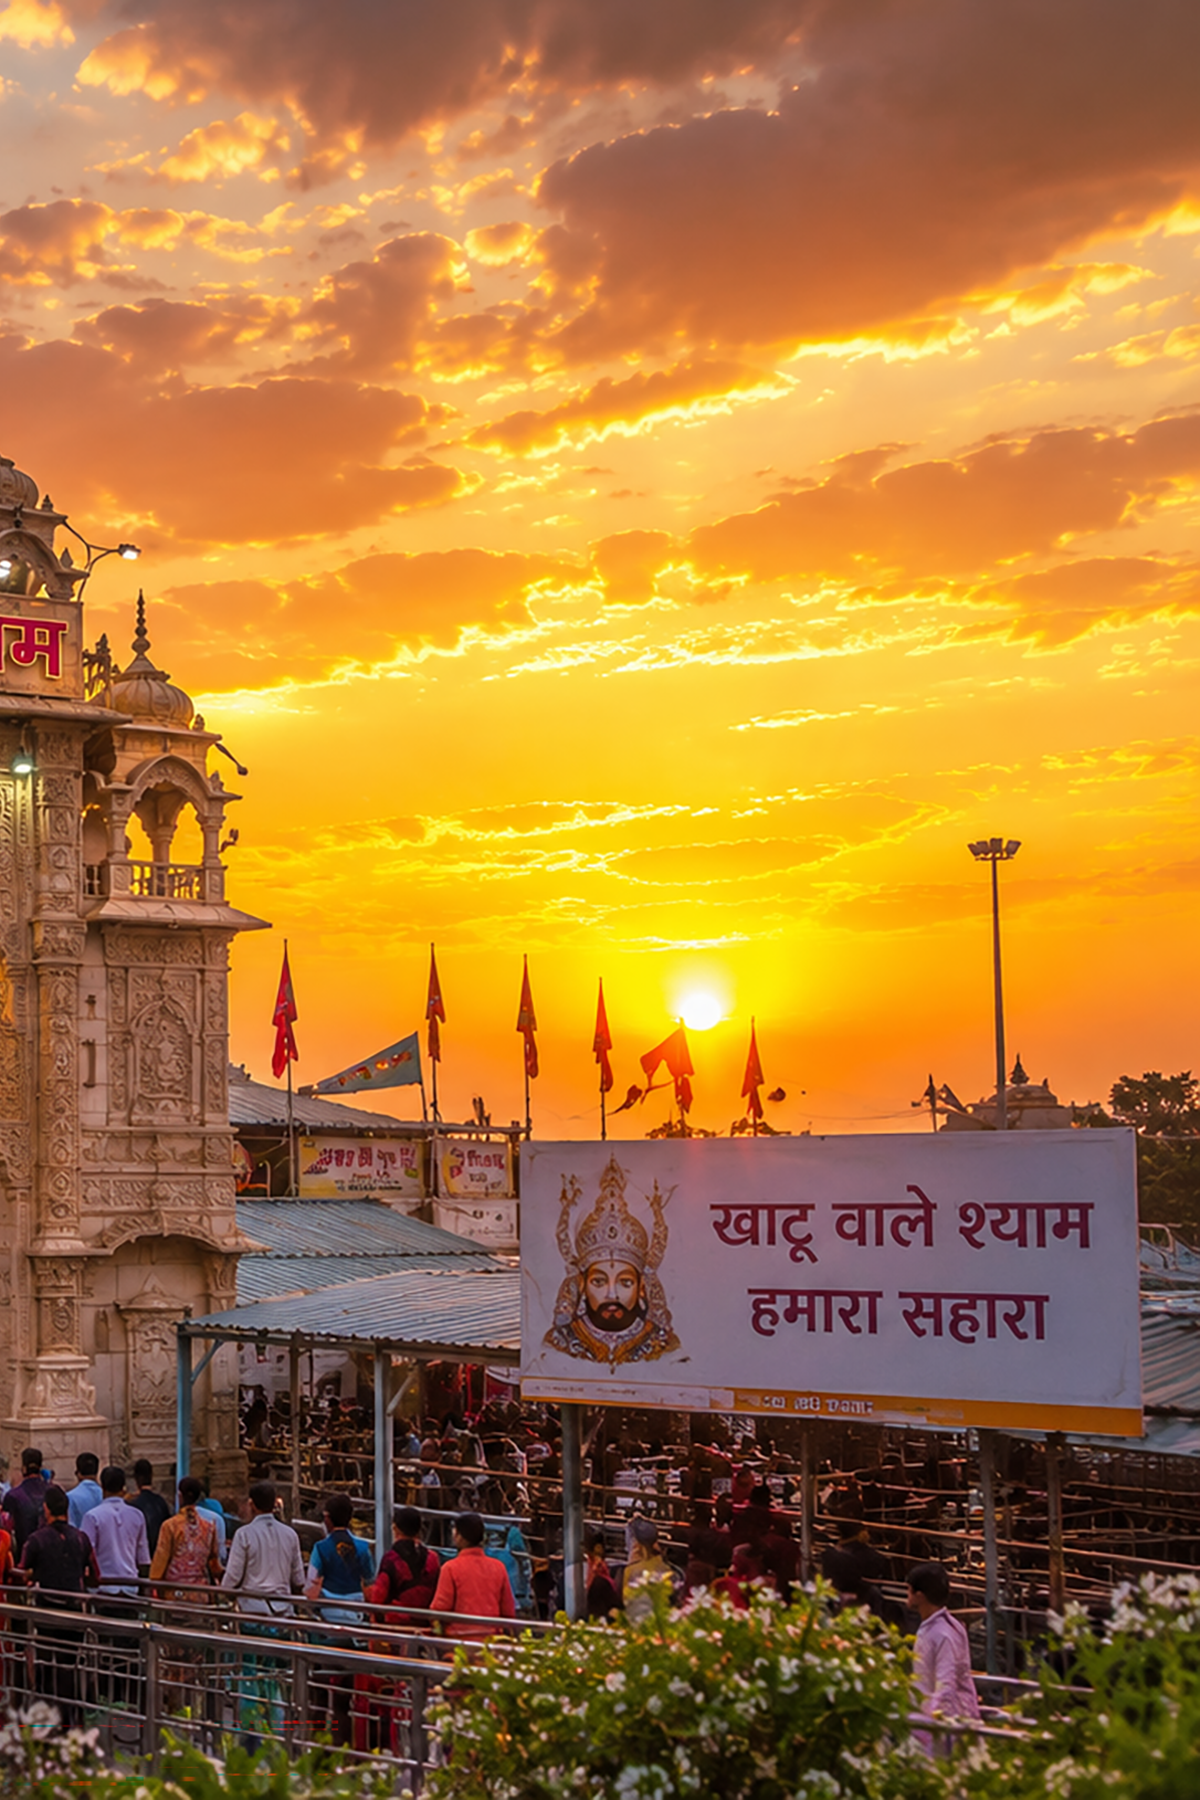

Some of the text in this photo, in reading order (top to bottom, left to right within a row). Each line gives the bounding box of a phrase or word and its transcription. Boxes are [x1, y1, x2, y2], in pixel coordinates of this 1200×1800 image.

[710, 1184, 1095, 1264] खाटू वाले श्याम
[747, 1288, 1050, 1344] हमारा सहारा
